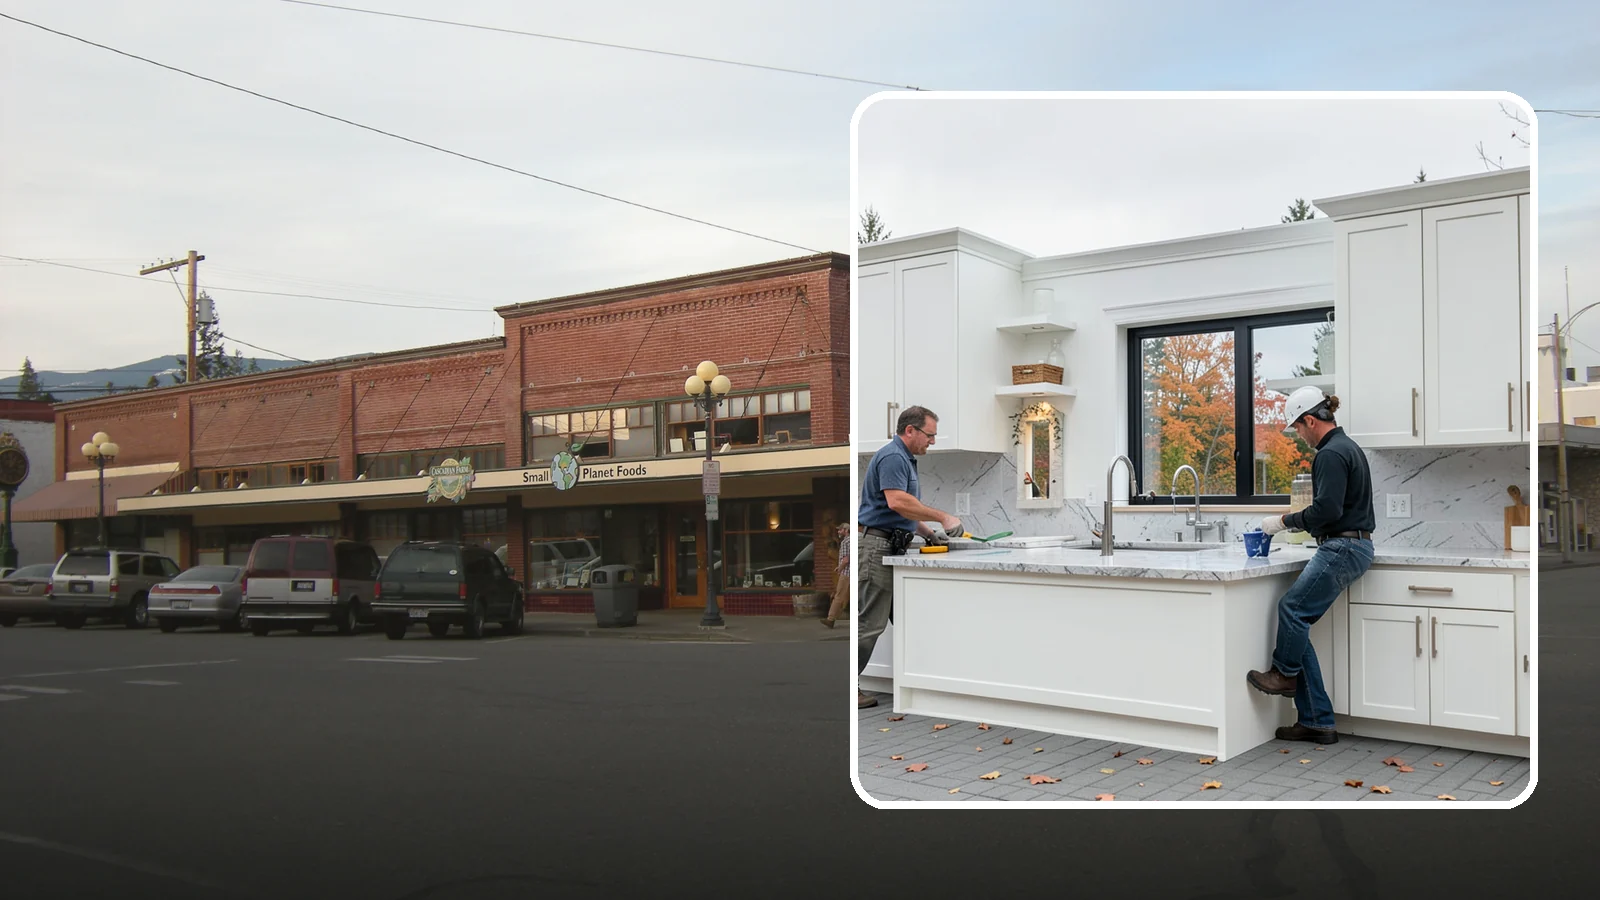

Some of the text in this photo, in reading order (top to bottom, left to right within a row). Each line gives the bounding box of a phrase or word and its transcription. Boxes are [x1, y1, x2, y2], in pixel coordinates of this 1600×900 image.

[523, 464, 647, 483] Small Planet Foods
